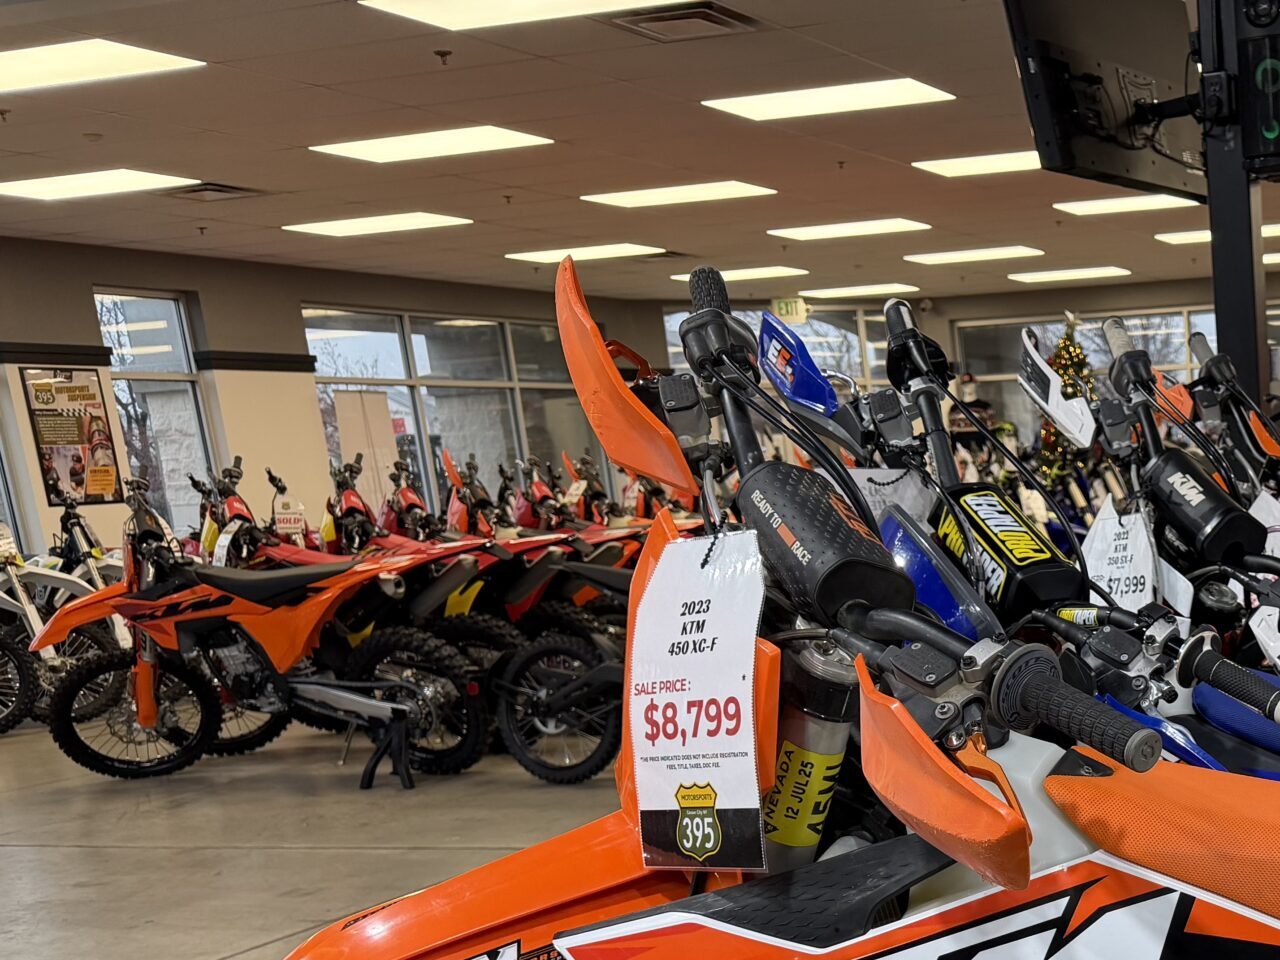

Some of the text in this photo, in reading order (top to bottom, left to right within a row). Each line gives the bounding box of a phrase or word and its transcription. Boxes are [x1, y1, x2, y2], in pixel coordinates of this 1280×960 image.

[778, 301, 798, 316] EXIT
[36, 391, 53, 402] 395
[1167, 472, 1206, 507] KTM
[750, 489, 812, 566] READY TO RACE
[1107, 575, 1146, 598] $7,999
[680, 599, 711, 616] 2023
[681, 619, 706, 636] KTM
[668, 637, 718, 656] 450 XC-F
[634, 681, 657, 696] SALE
[644, 696, 742, 747] $8,799
[764, 750, 795, 820] NEVADA
[783, 760, 815, 820] 12 JUL 25
[681, 793, 713, 801] MOTORSPORTS
[682, 817, 715, 849] 395
